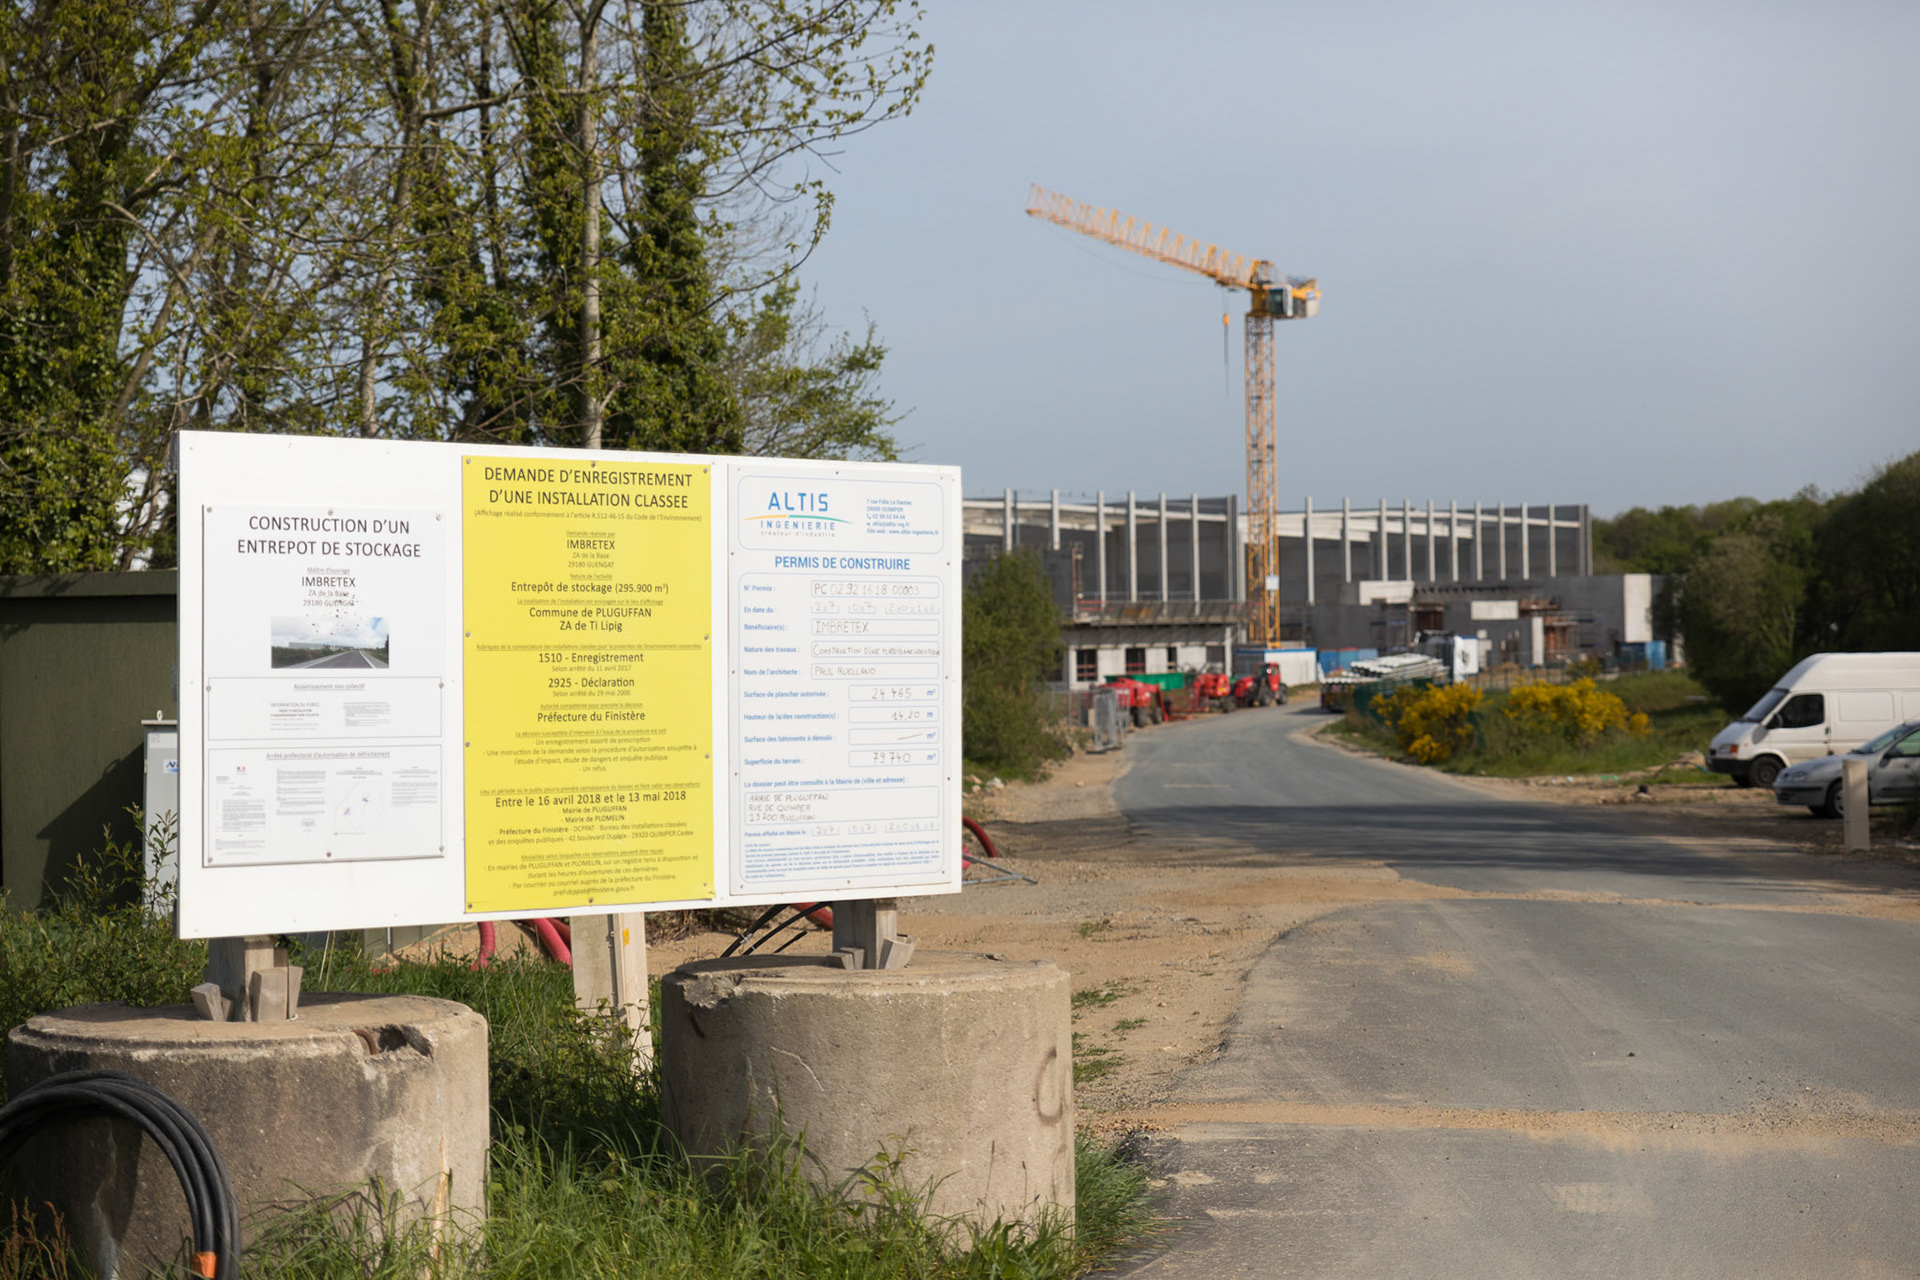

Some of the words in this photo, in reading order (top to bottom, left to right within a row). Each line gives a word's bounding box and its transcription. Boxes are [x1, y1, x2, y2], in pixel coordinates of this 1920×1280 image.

[485, 468, 554, 482] DEMANDE
[560, 470, 692, 486] D'ENREGISTREMENT
[490, 490, 532, 504] D'UNE
[538, 492, 630, 506] INSTALLATION
[635, 495, 687, 508] CLASSEE
[768, 492, 829, 512] ALTIS
[249, 516, 367, 532] CONSTRUCTION
[373, 520, 410, 534] D'UN
[760, 521, 835, 530] INGENIERIE
[238, 540, 316, 554] ENTREPOT
[322, 542, 339, 555] DE
[346, 542, 420, 557] STOCKAGE
[567, 540, 615, 550] IMBRETEX
[775, 556, 819, 568] PERMIS
[822, 557, 836, 569] DE
[840, 558, 910, 570] CONSTRUIRE
[302, 577, 355, 587] IMBRETEX
[511, 582, 554, 593] Entrepôt
[556, 582, 568, 592] de
[571, 583, 612, 594] stockage
[615, 584, 652, 593] (295.900
[654, 583, 669, 594] m³)
[529, 608, 578, 617] Commune
[581, 607, 593, 618] de
[596, 608, 652, 617] PLUGUFFAN
[560, 620, 572, 630] ZA
[575, 620, 587, 631] de
[591, 620, 598, 630] Ti
[601, 621, 623, 632] Lipig
[539, 653, 563, 663] 1510
[572, 653, 644, 664] Enregistrement
[549, 678, 572, 688] 2925
[581, 678, 635, 687] Déclaration
[537, 712, 588, 722] Préfecture
[590, 712, 602, 721] du
[605, 711, 645, 721] Finistère
[496, 798, 522, 807] Entre
[526, 796, 534, 806] le
[539, 796, 550, 806] 16
[553, 795, 574, 805] avril
[578, 794, 601, 804] 2018
[604, 794, 613, 803] et
[616, 793, 625, 803] le
[630, 792, 640, 802] 13
[643, 792, 660, 801] mai
[664, 791, 686, 801] 2018
